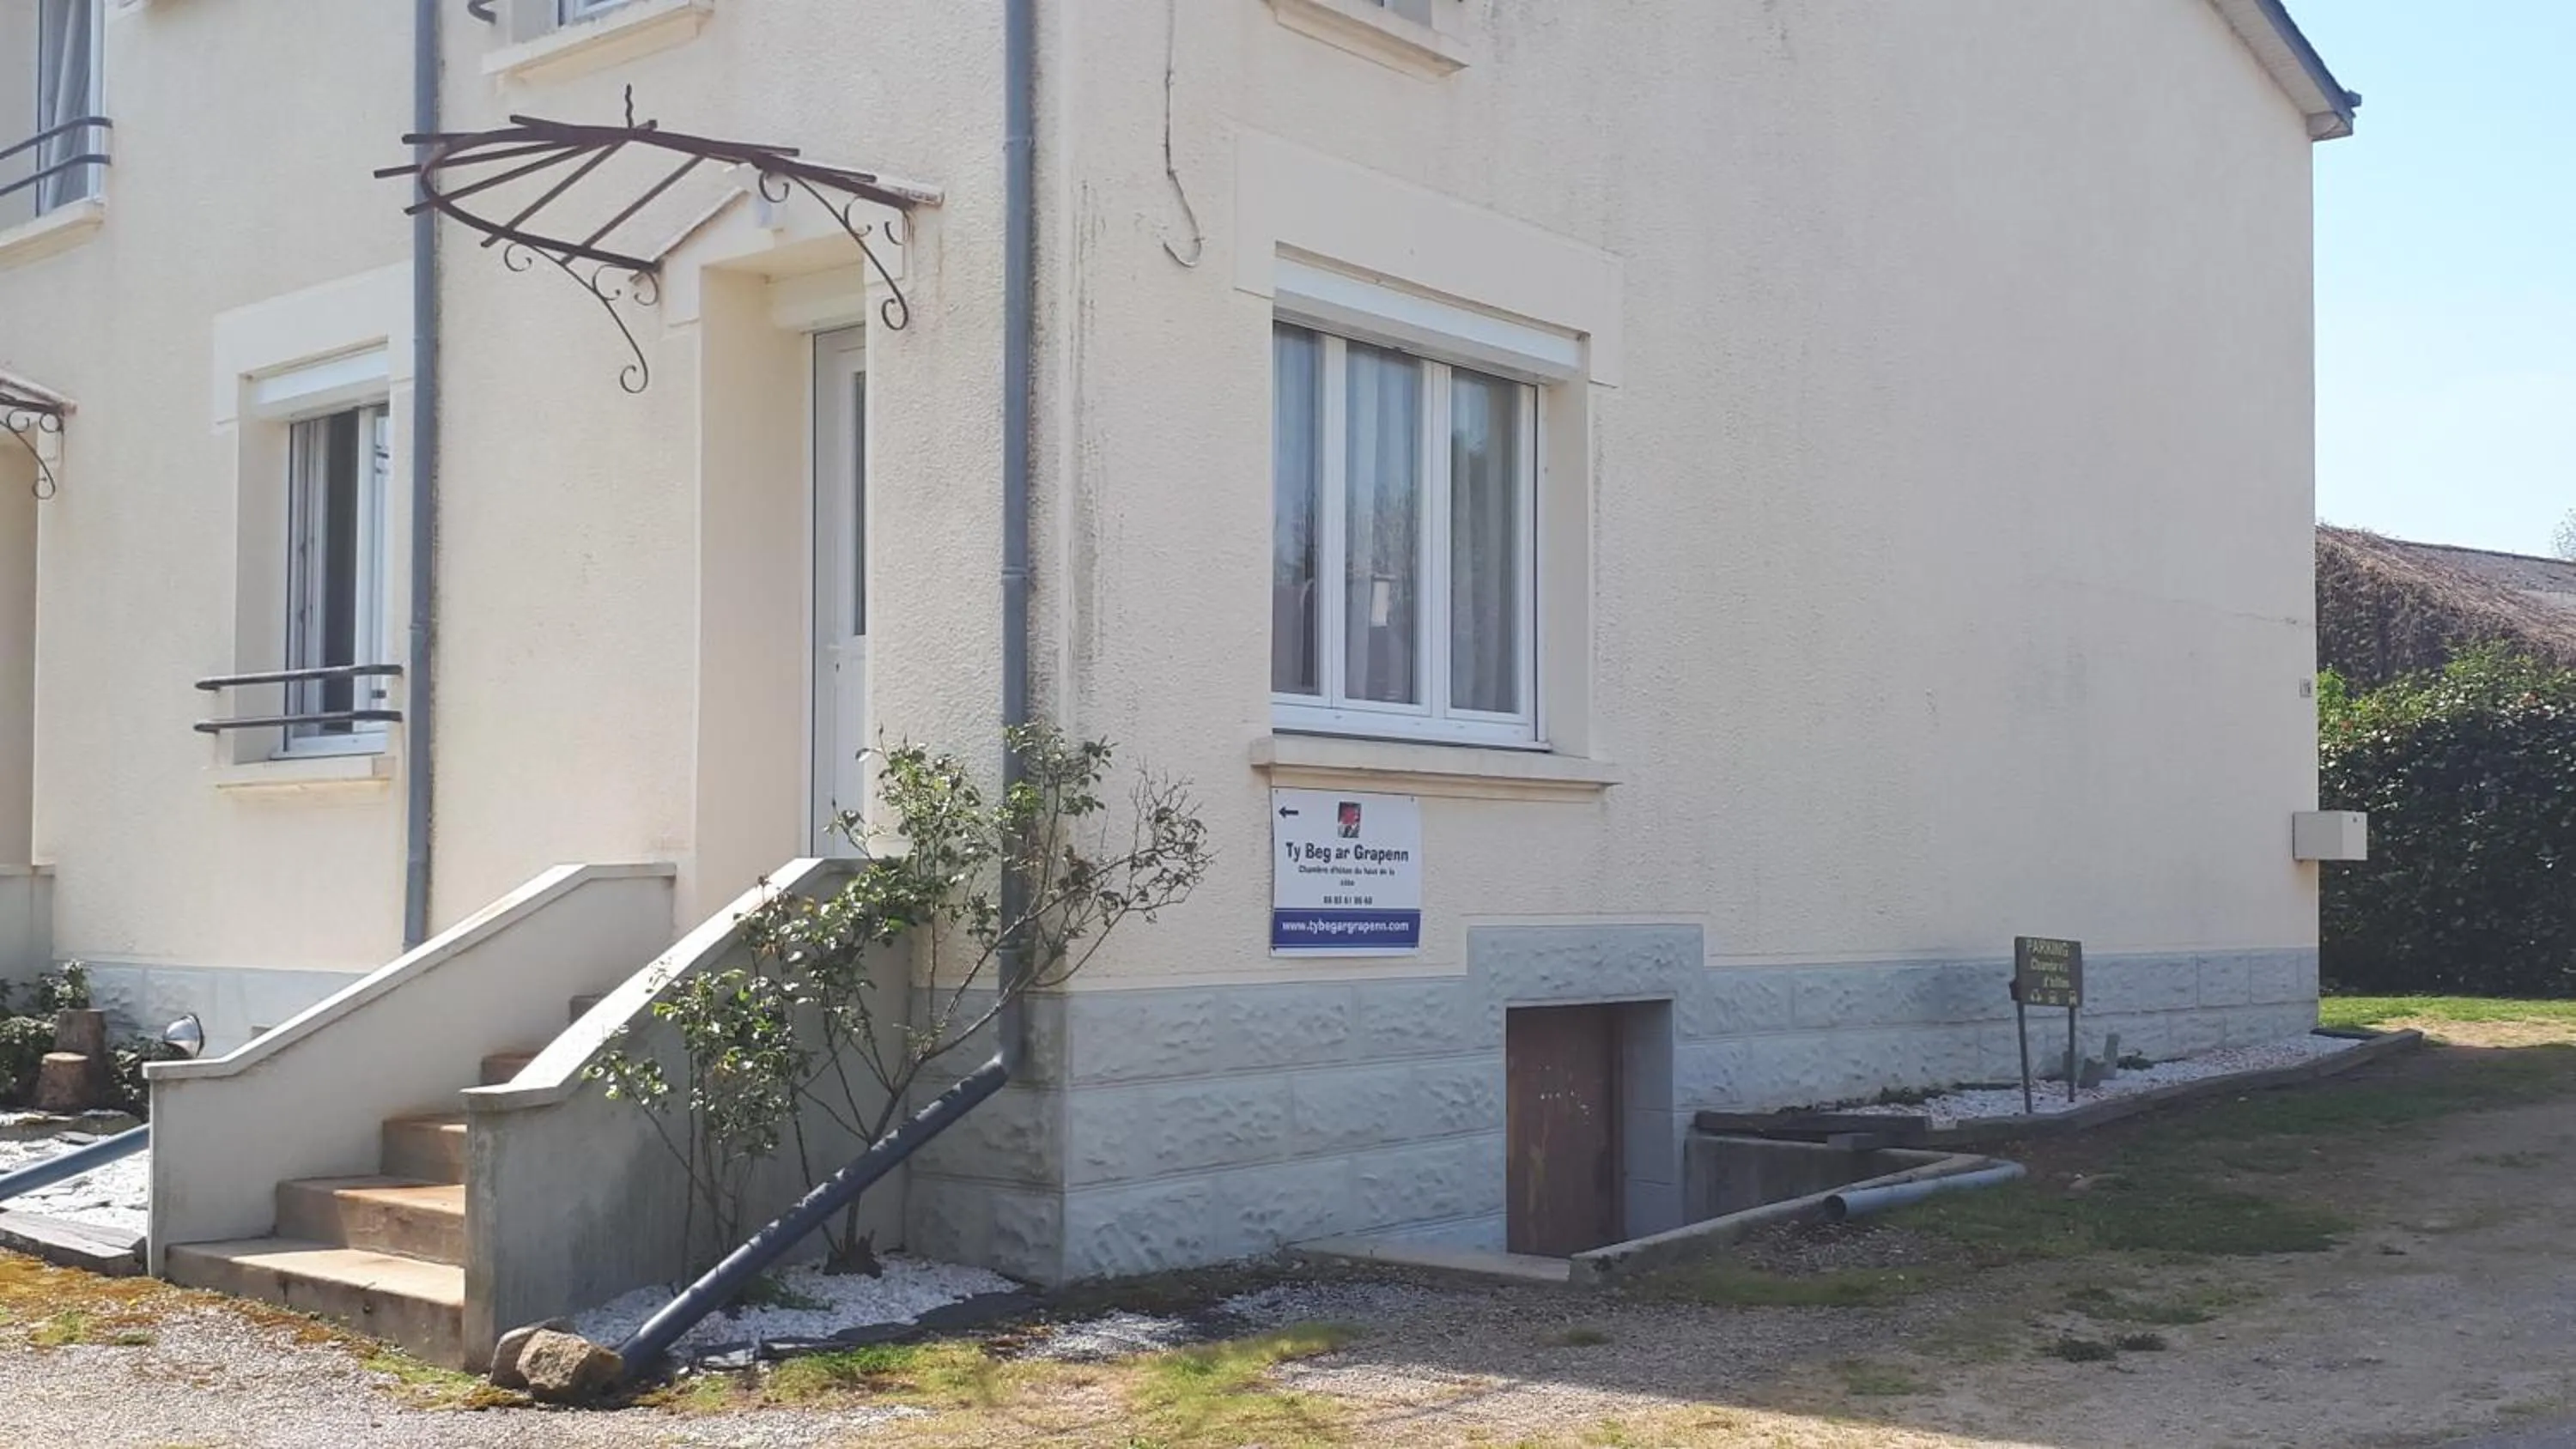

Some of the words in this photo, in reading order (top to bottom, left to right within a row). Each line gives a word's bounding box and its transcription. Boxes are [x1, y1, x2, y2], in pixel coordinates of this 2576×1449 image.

[1285, 841, 1301, 863] Ty
[1305, 842, 1331, 864] Beg
[1335, 847, 1350, 859] ar
[1354, 844, 1409, 864] Grapenn
[1282, 918, 1409, 934] www.tybegargrapenn.com
[2026, 938, 2069, 957] PARKING
